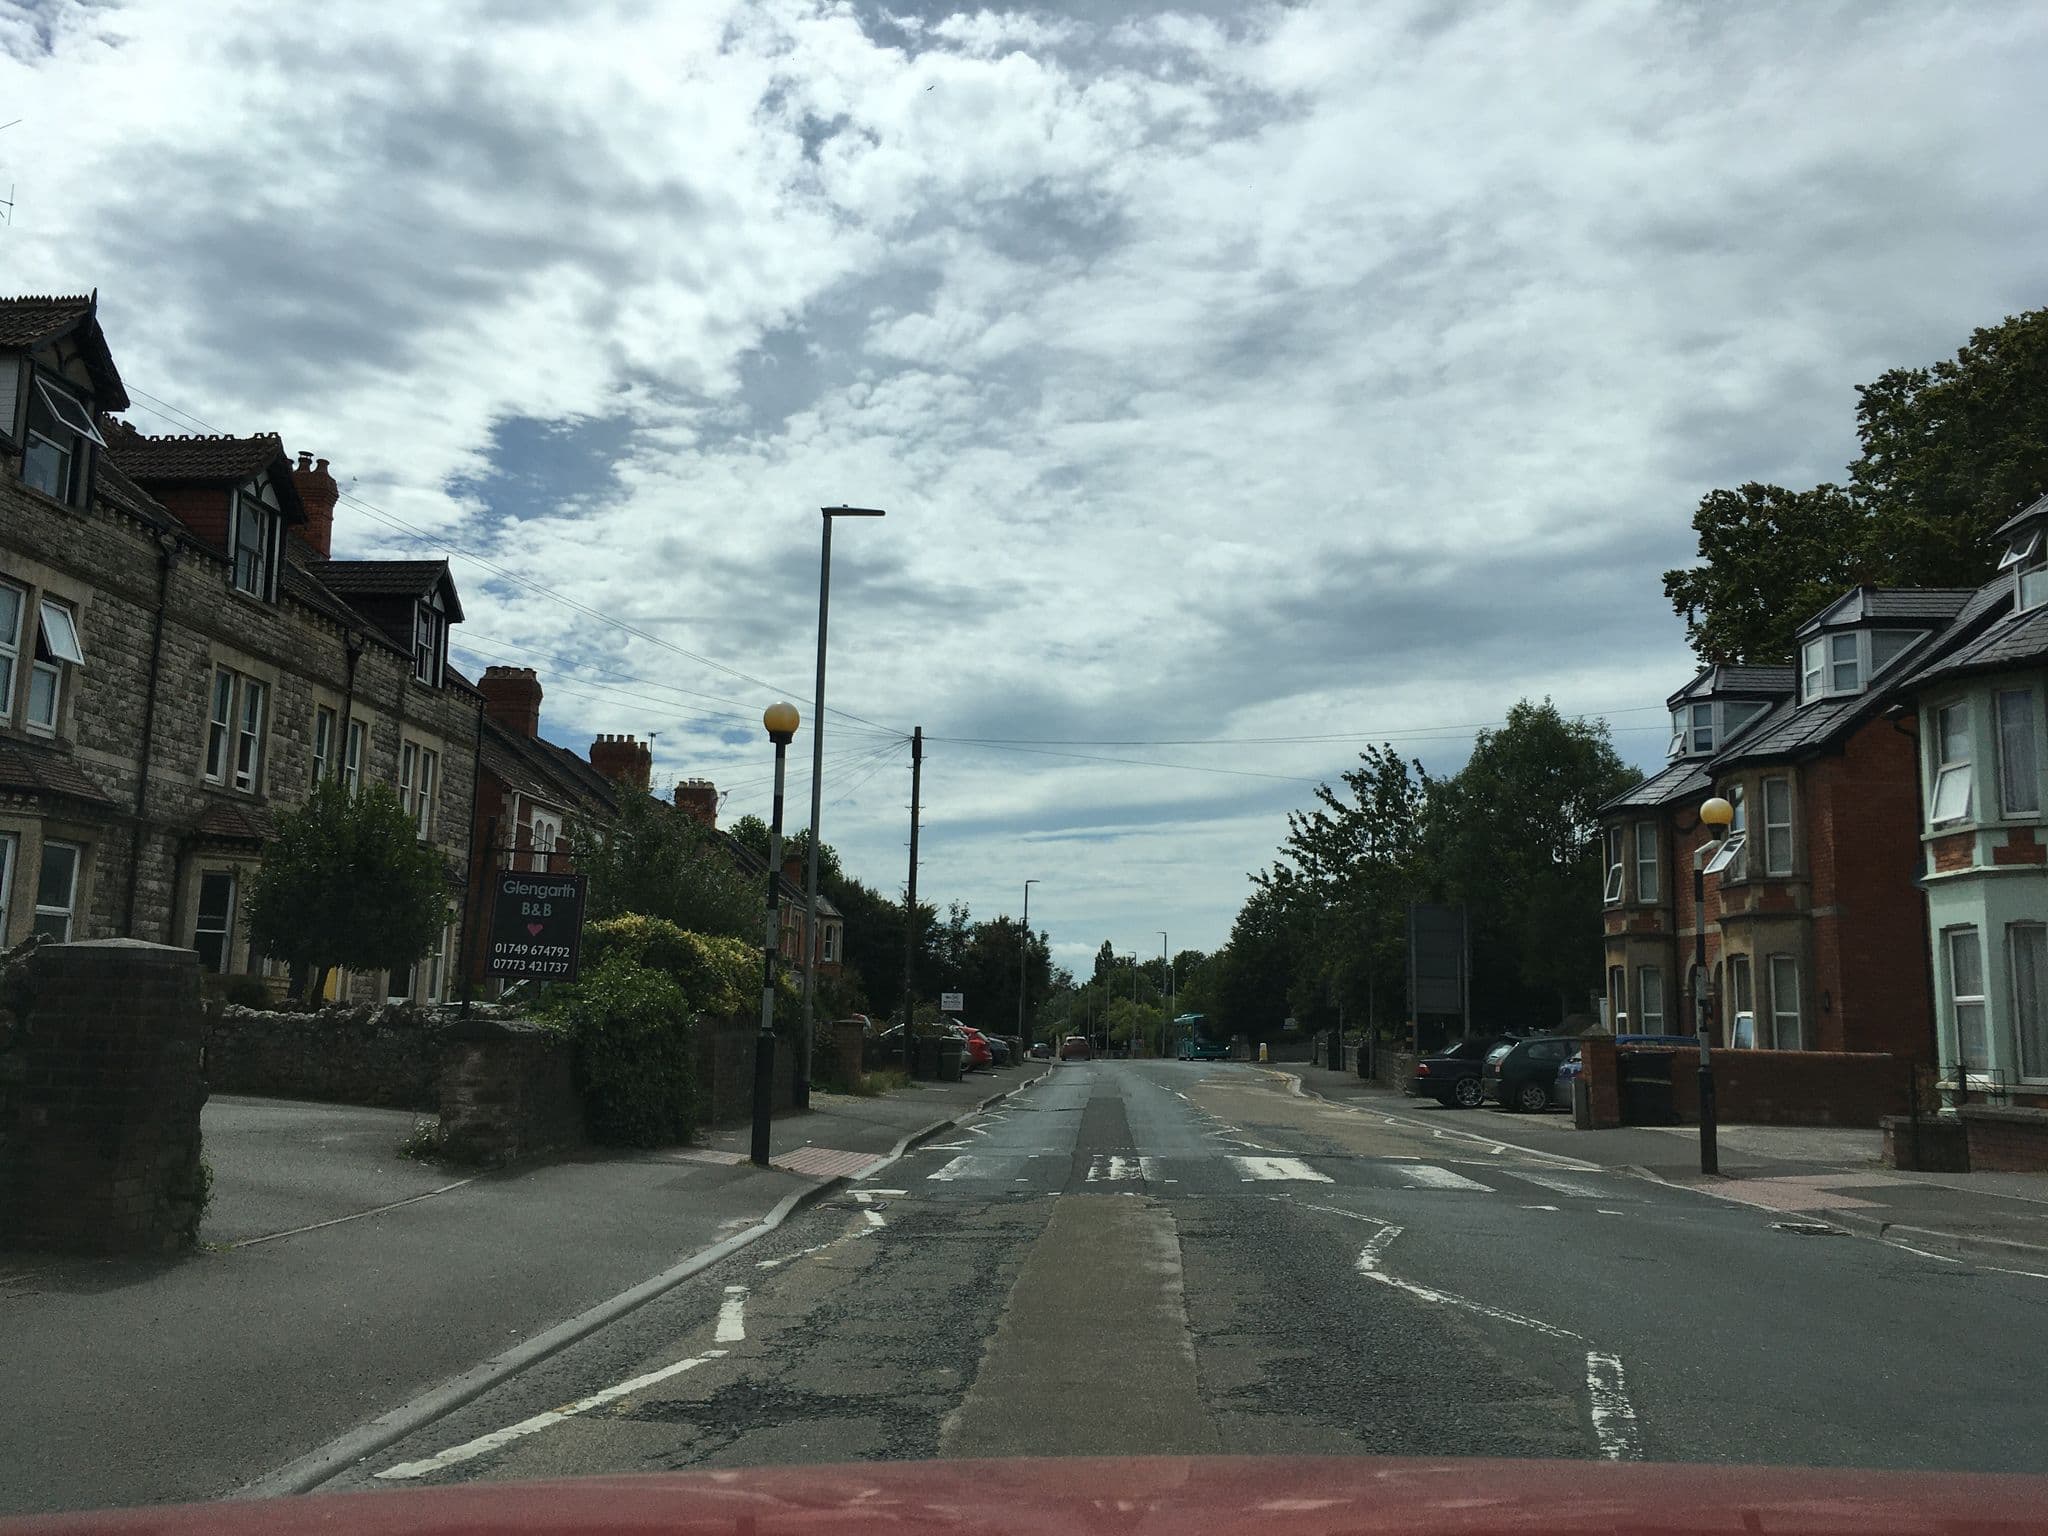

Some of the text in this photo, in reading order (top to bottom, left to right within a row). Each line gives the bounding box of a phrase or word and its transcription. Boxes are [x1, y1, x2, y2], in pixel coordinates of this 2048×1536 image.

[503, 880, 575, 899] Glengarth
[495, 943, 570, 957] 01749 674792
[493, 958, 568, 973] 07773 421737
